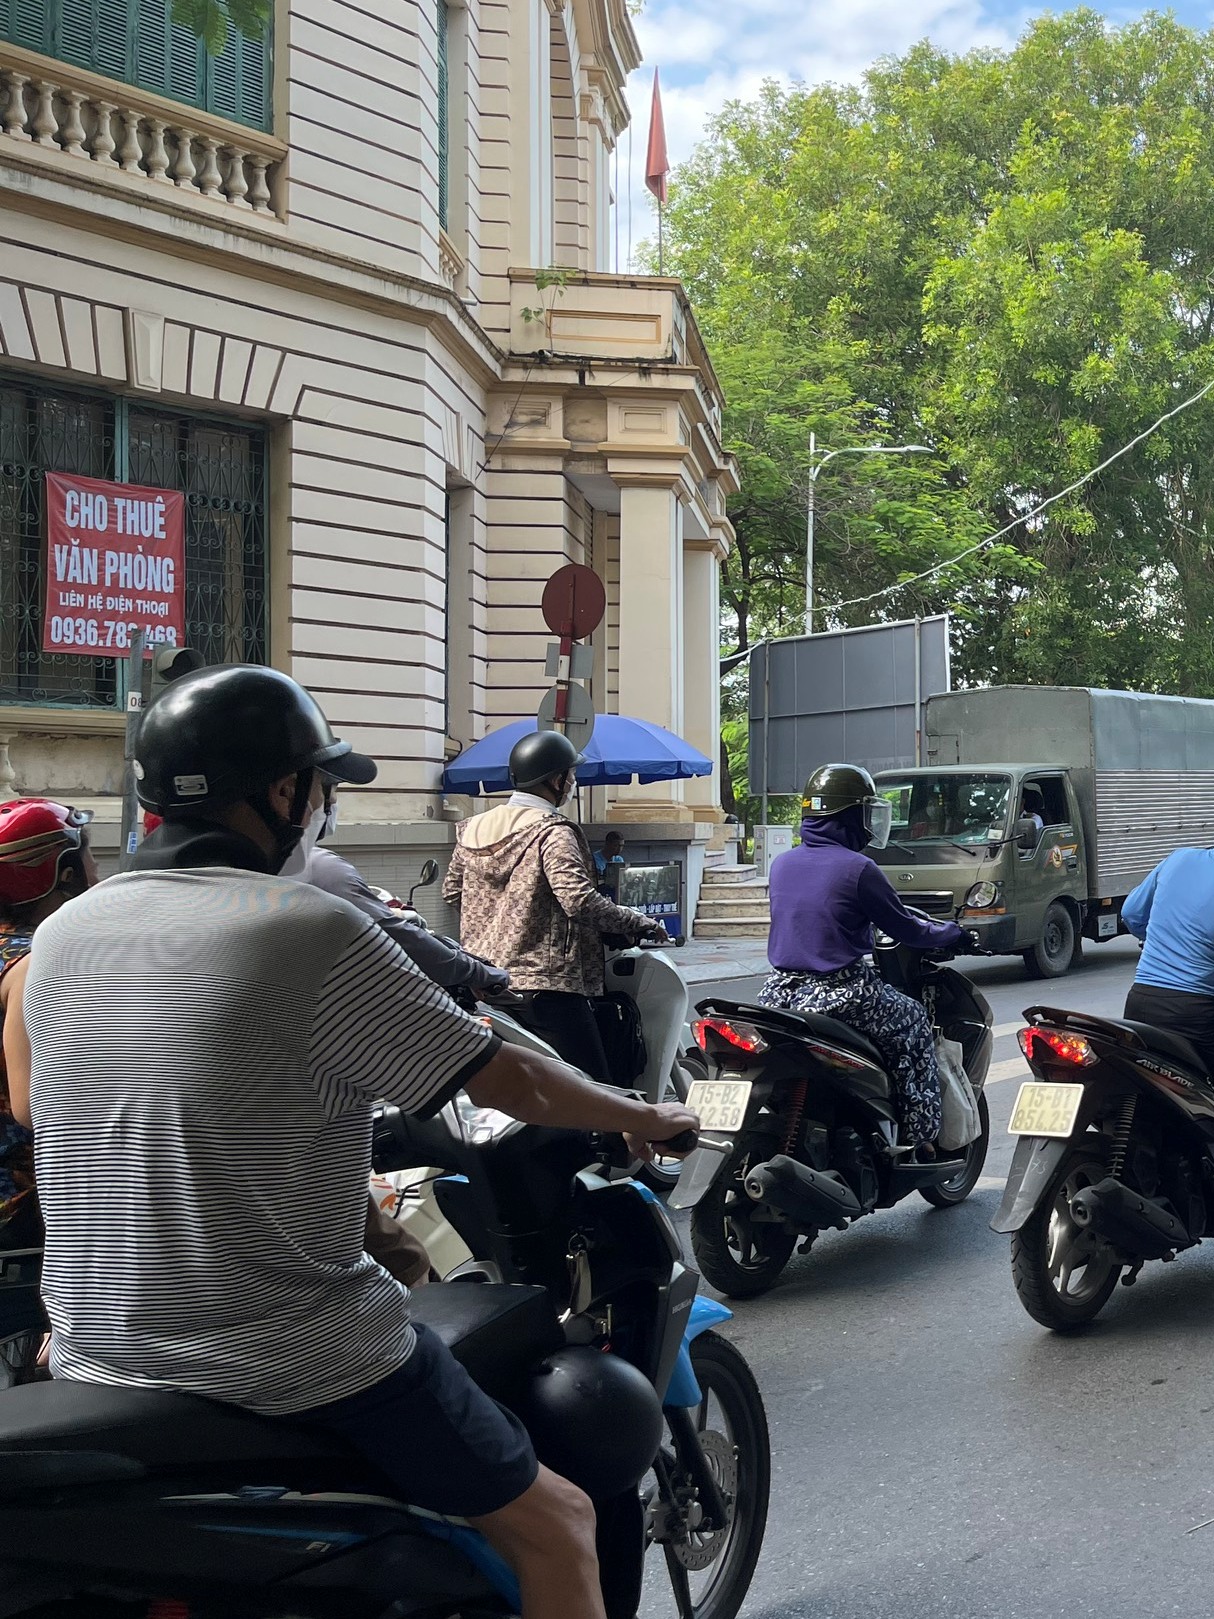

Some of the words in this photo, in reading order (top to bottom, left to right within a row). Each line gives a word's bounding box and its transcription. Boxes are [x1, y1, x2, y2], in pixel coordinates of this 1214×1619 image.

[66, 490, 108, 532] CHO
[114, 496, 166, 539] THUÊ
[54, 538, 98, 585] VĂN
[105, 545, 175, 593] PHÒNG
[59, 590, 84, 607] LIÊN
[88, 592, 103, 612] HỆ
[106, 594, 133, 614] ĐIỆN
[136, 599, 169, 618] THOẠI
[50, 615, 177, 650] 0936.78468
[699, 1085, 741, 1105] 15-B2
